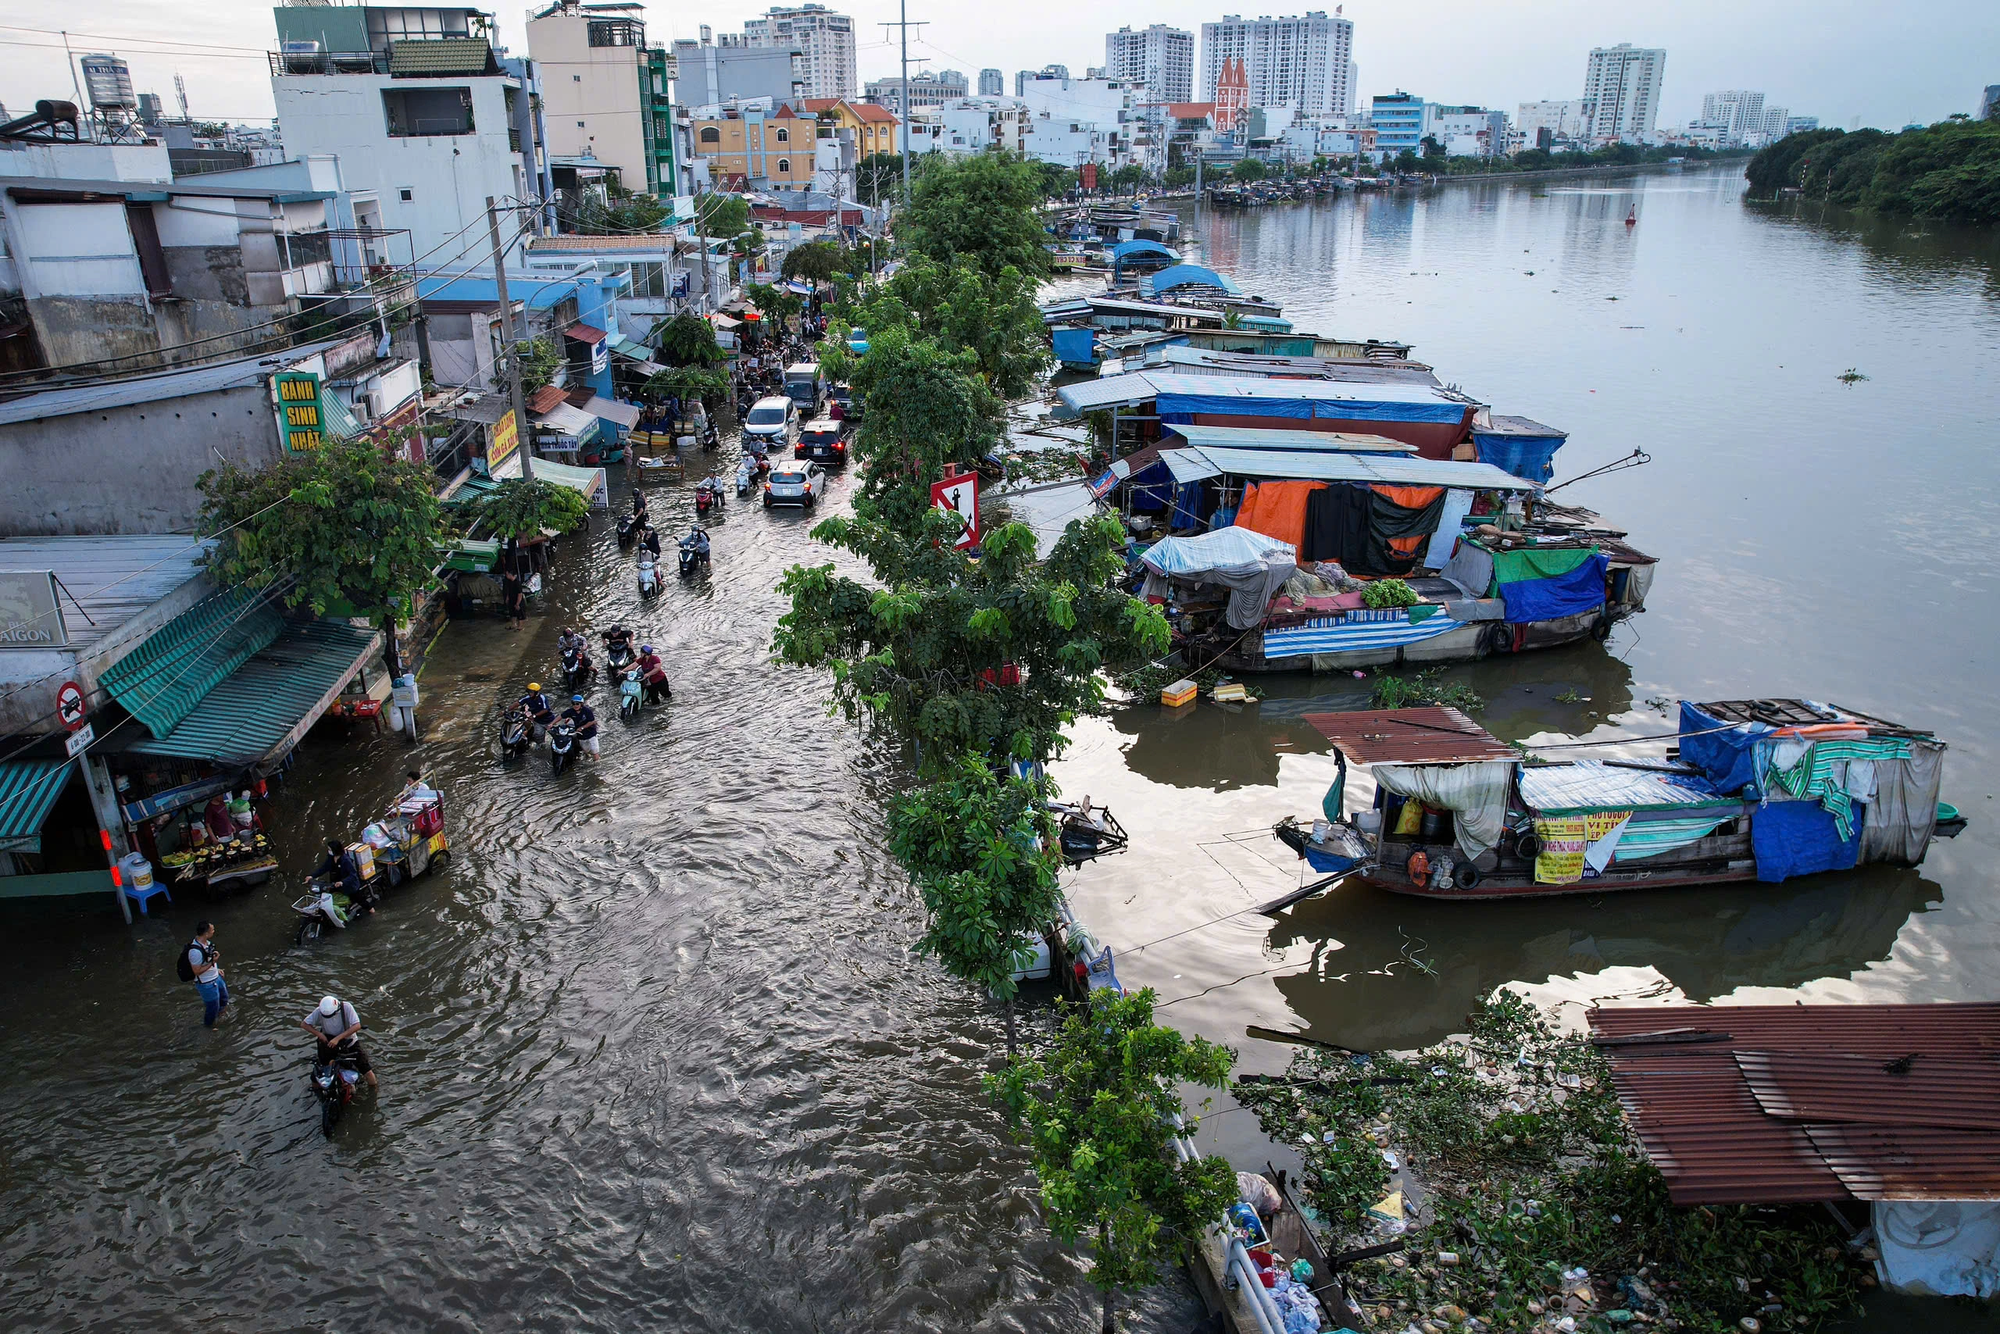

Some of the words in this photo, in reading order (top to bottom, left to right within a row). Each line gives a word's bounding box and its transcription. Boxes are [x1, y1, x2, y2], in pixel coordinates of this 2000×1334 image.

[280, 378, 315, 400] BÁNH
[286, 406, 318, 426] SINH
[1588, 821, 1601, 829] VI
